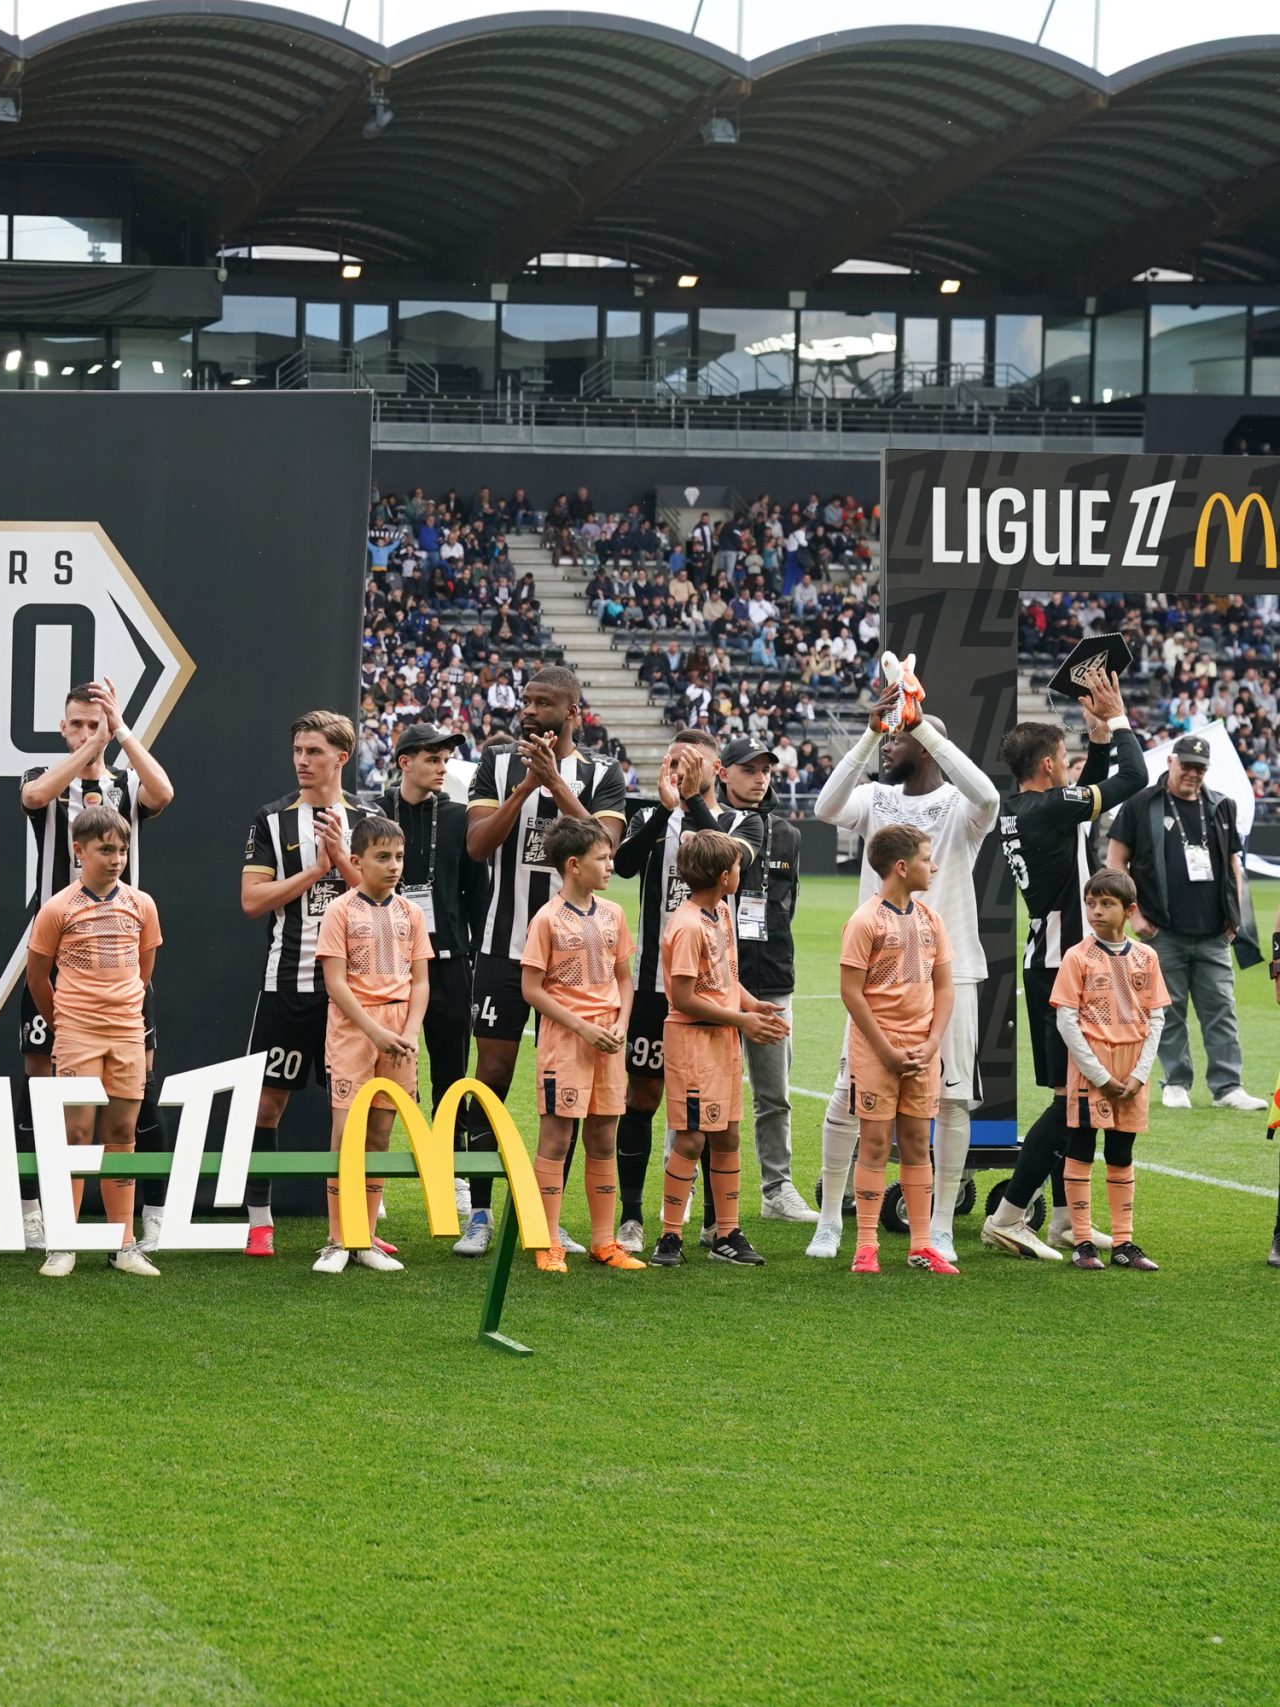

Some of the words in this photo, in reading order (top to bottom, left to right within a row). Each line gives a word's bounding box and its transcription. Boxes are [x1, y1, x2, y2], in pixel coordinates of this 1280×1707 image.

[932, 487, 1111, 566] LIGUE
[481, 996, 497, 1027] 4
[30, 1015, 47, 1045] 8
[266, 1047, 302, 1080] 20
[632, 1037, 664, 1069] 93
